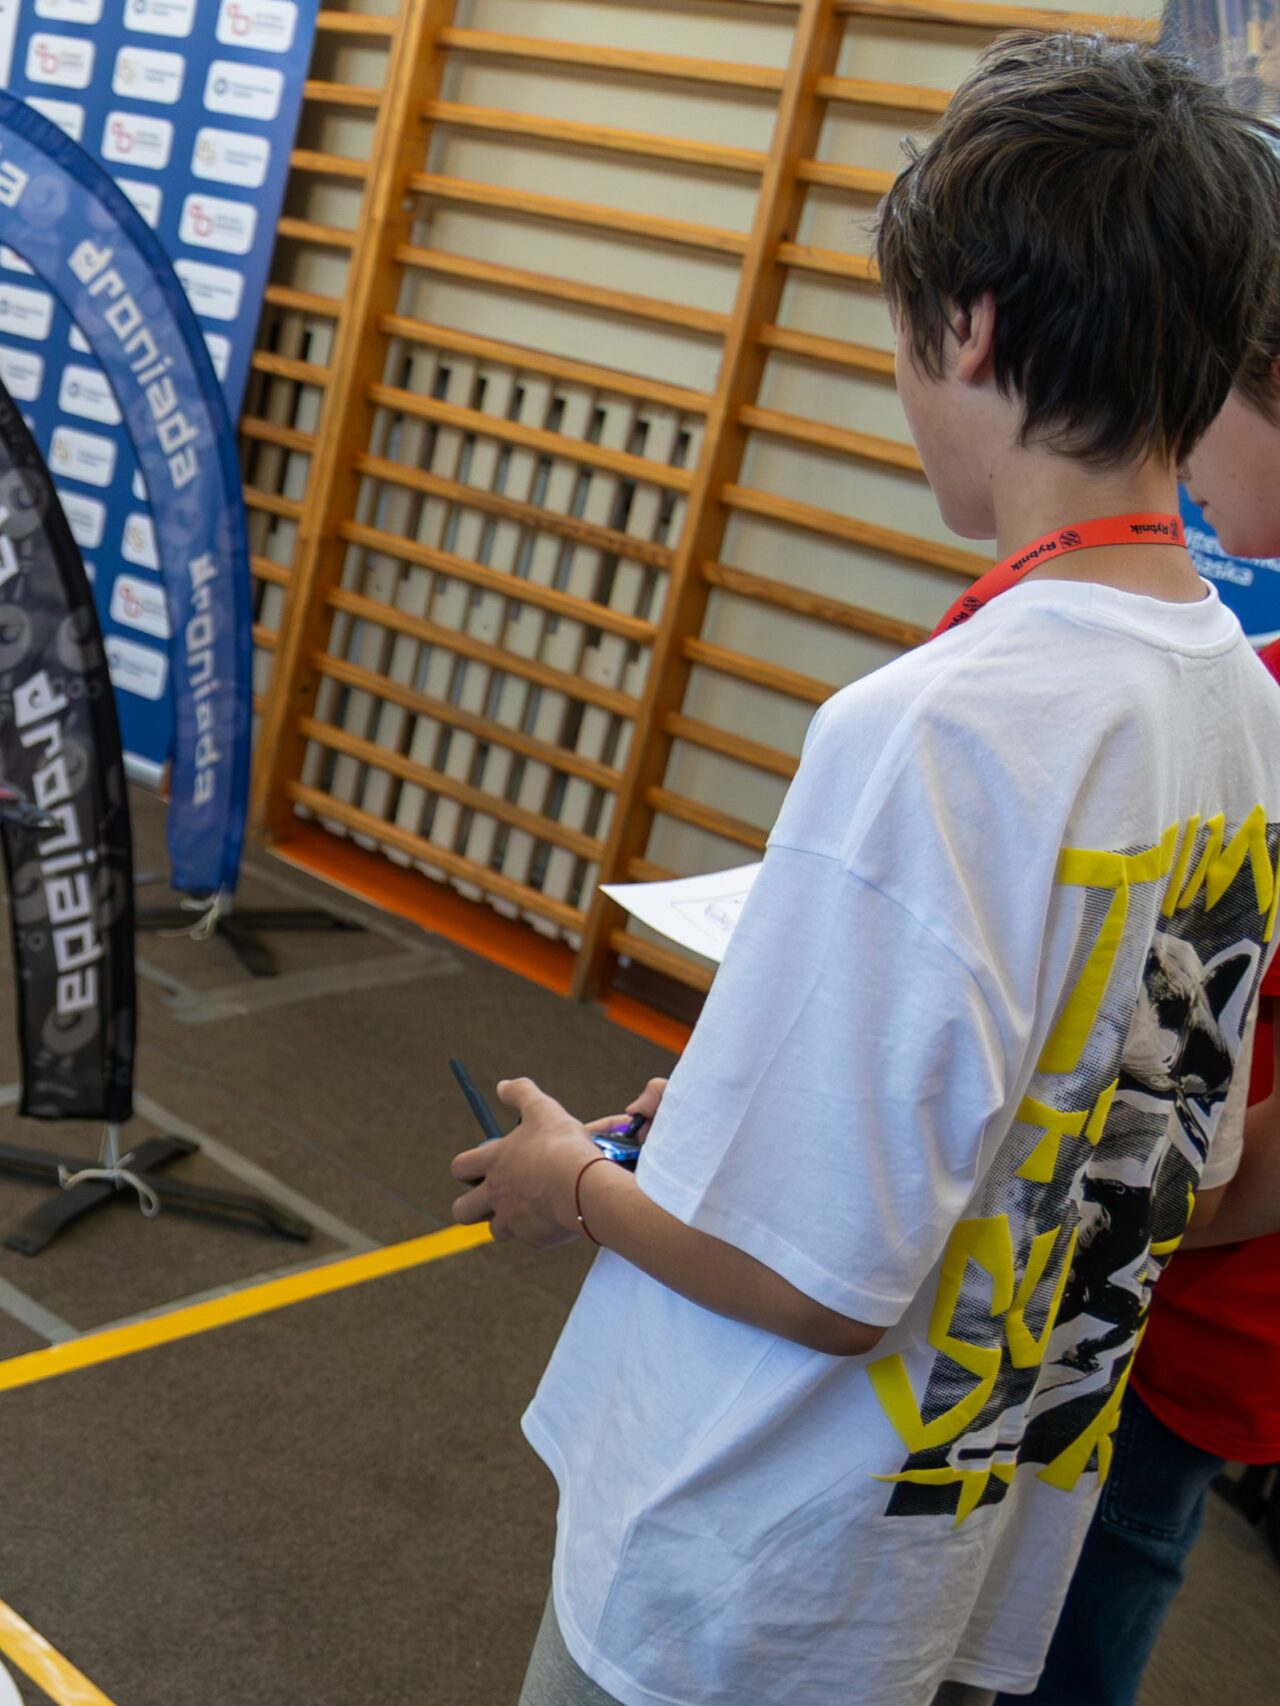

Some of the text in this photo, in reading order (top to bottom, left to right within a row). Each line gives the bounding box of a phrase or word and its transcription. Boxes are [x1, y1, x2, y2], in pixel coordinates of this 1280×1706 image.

[68, 240, 200, 488] droniada
[1010, 541, 1057, 571] Rybnik
[1130, 524, 1169, 536] Rybnik
[186, 552, 218, 806] droniada
[13, 671, 104, 1014] droniada
